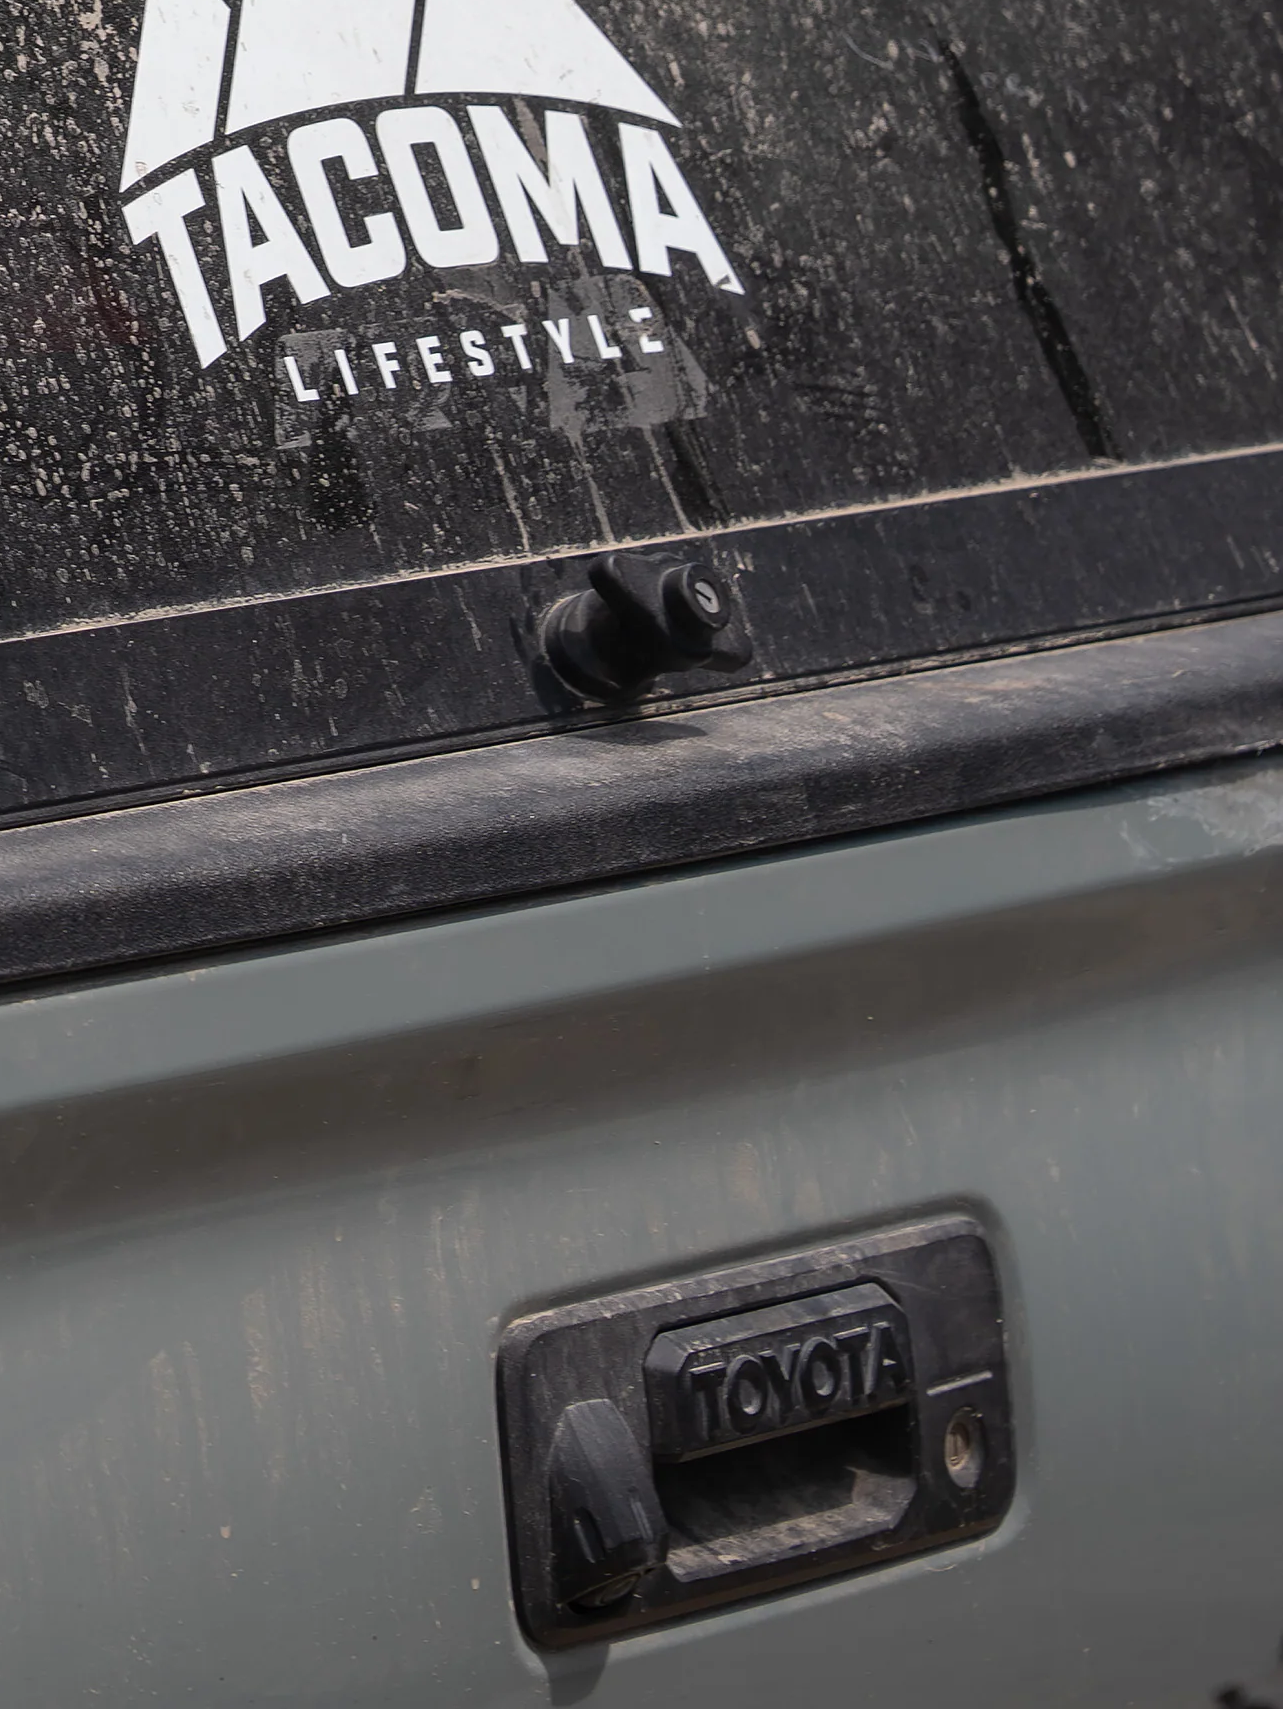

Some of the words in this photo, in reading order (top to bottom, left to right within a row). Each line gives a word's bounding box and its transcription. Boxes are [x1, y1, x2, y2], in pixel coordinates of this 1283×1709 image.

[120, 105, 746, 370] TACOMA
[283, 306, 665, 404] LIFESTYLE
[686, 1320, 910, 1443] TOYOTA
